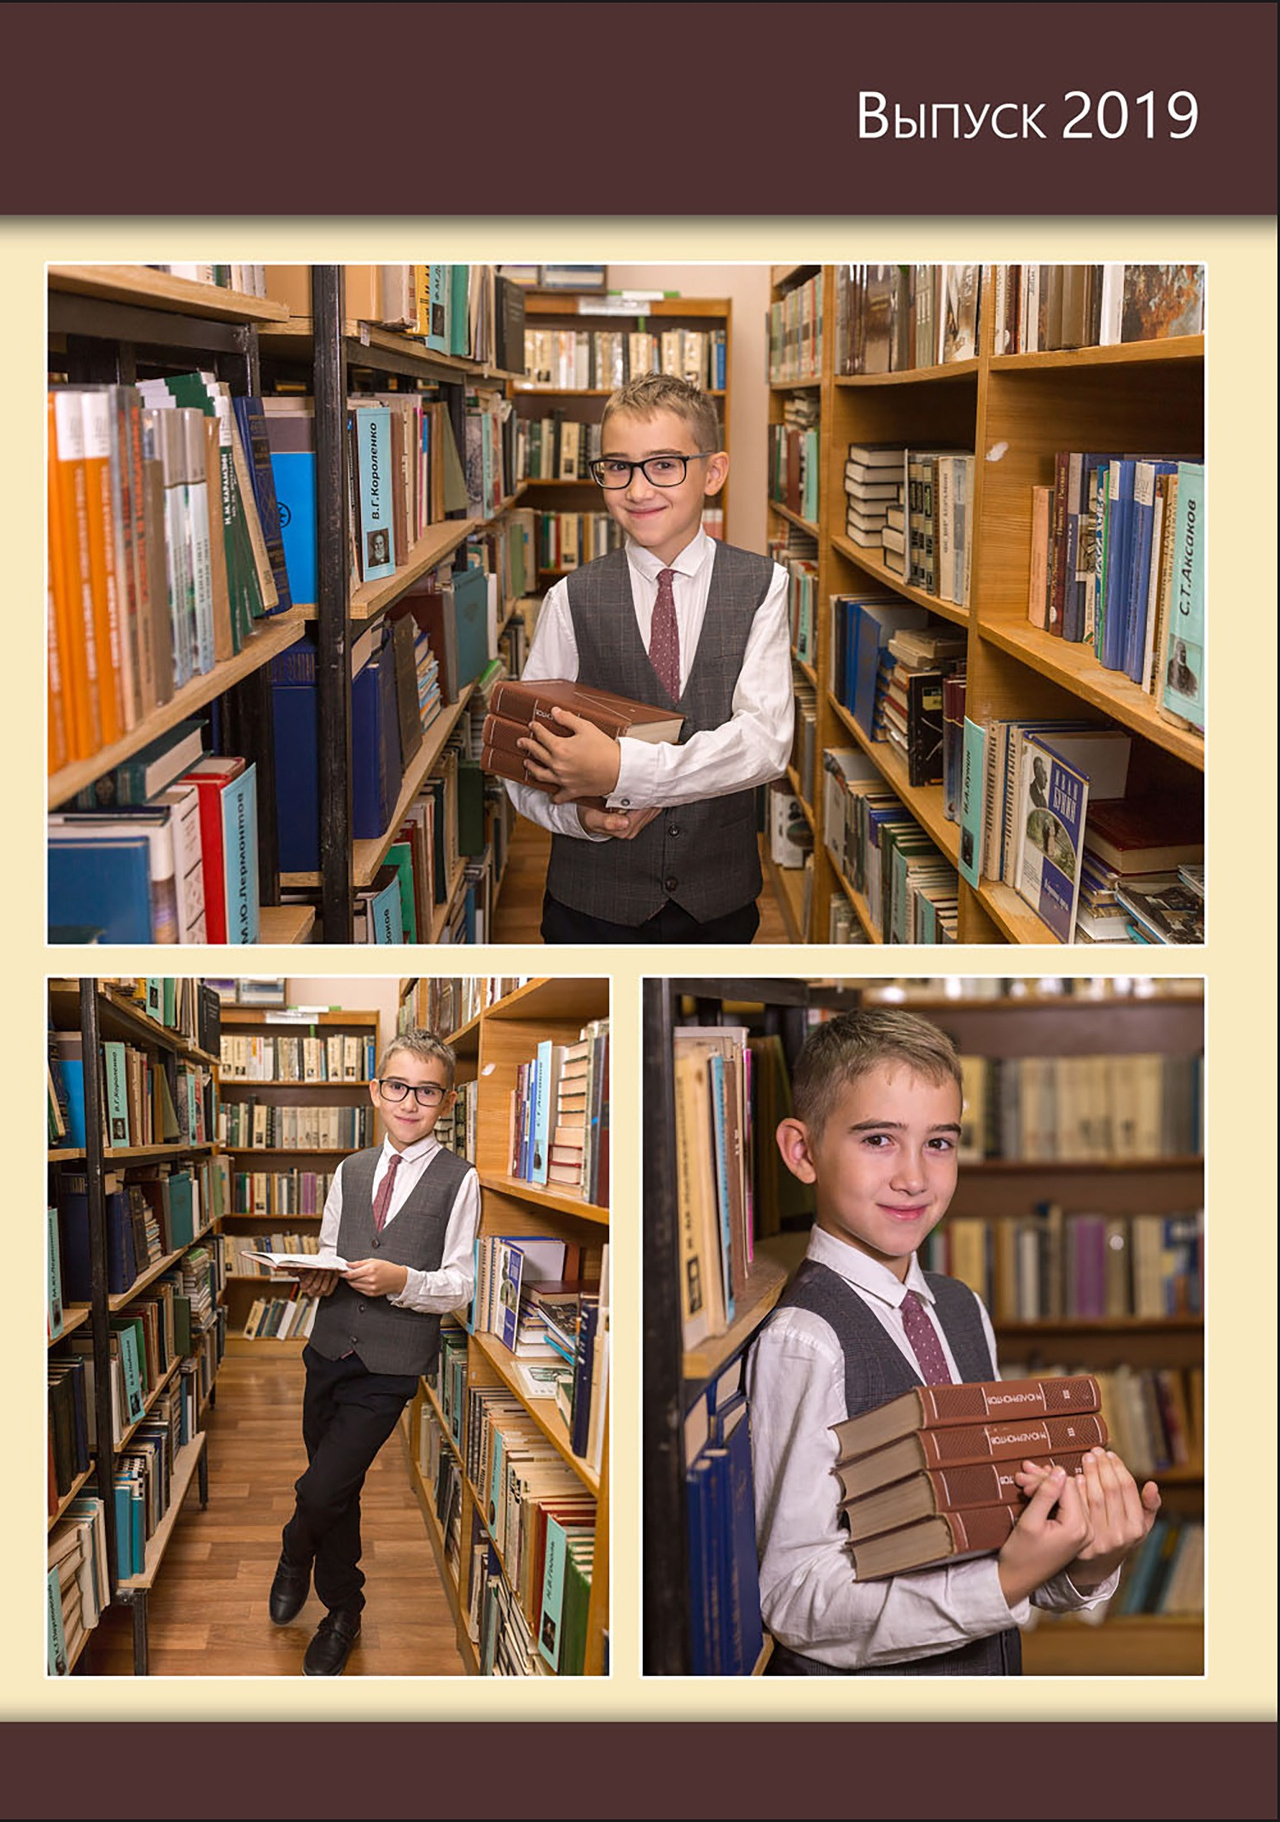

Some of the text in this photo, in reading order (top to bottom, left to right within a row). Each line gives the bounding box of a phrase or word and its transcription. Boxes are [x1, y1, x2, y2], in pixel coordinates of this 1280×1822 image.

[221, 453, 231, 503] КАРАМЗИН
[369, 422, 380, 520] В.Г.Короленко
[1179, 498, 1197, 616] С.Т.Аксаков
[235, 792, 250, 944] М.Ю.Лермонтов
